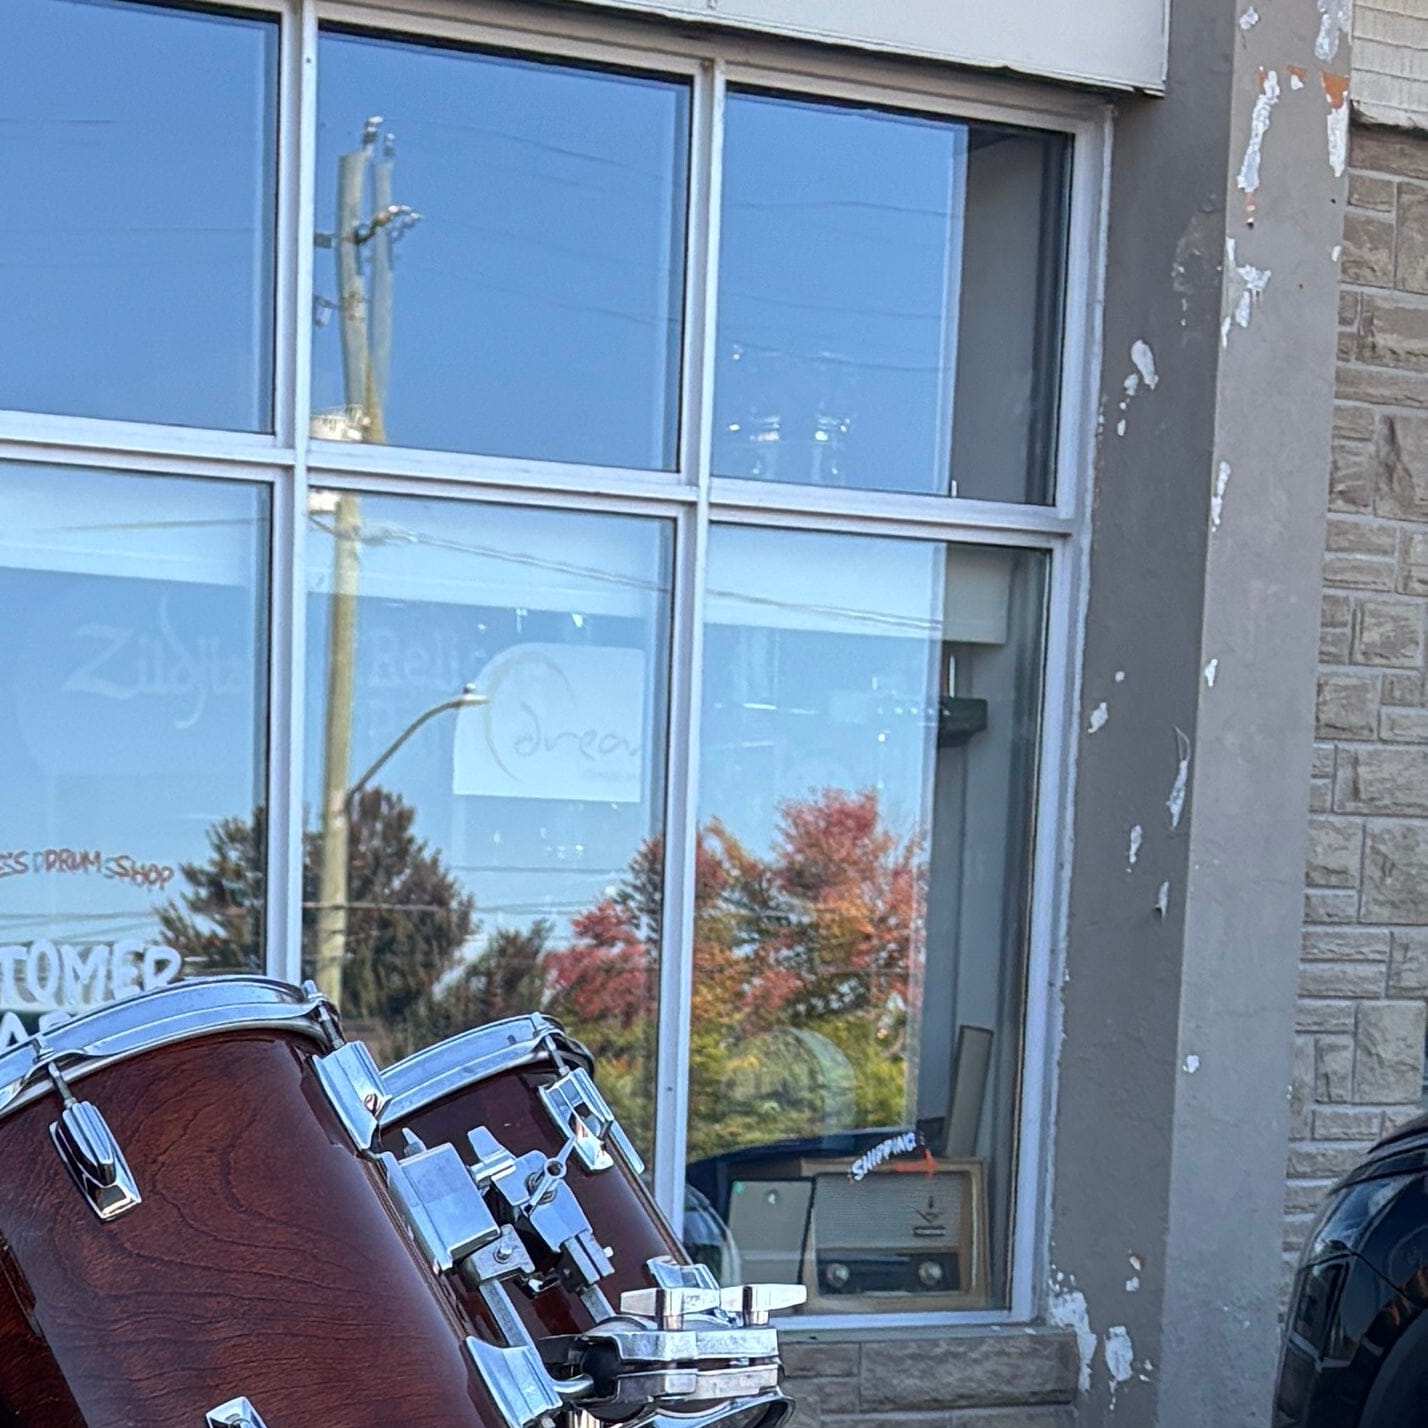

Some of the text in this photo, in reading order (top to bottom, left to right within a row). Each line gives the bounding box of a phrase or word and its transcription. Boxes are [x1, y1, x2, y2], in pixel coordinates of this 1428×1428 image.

[43, 848, 101, 874] DRUM
[112, 854, 174, 891] SHOP
[852, 1132, 917, 1181] SHIPPING
